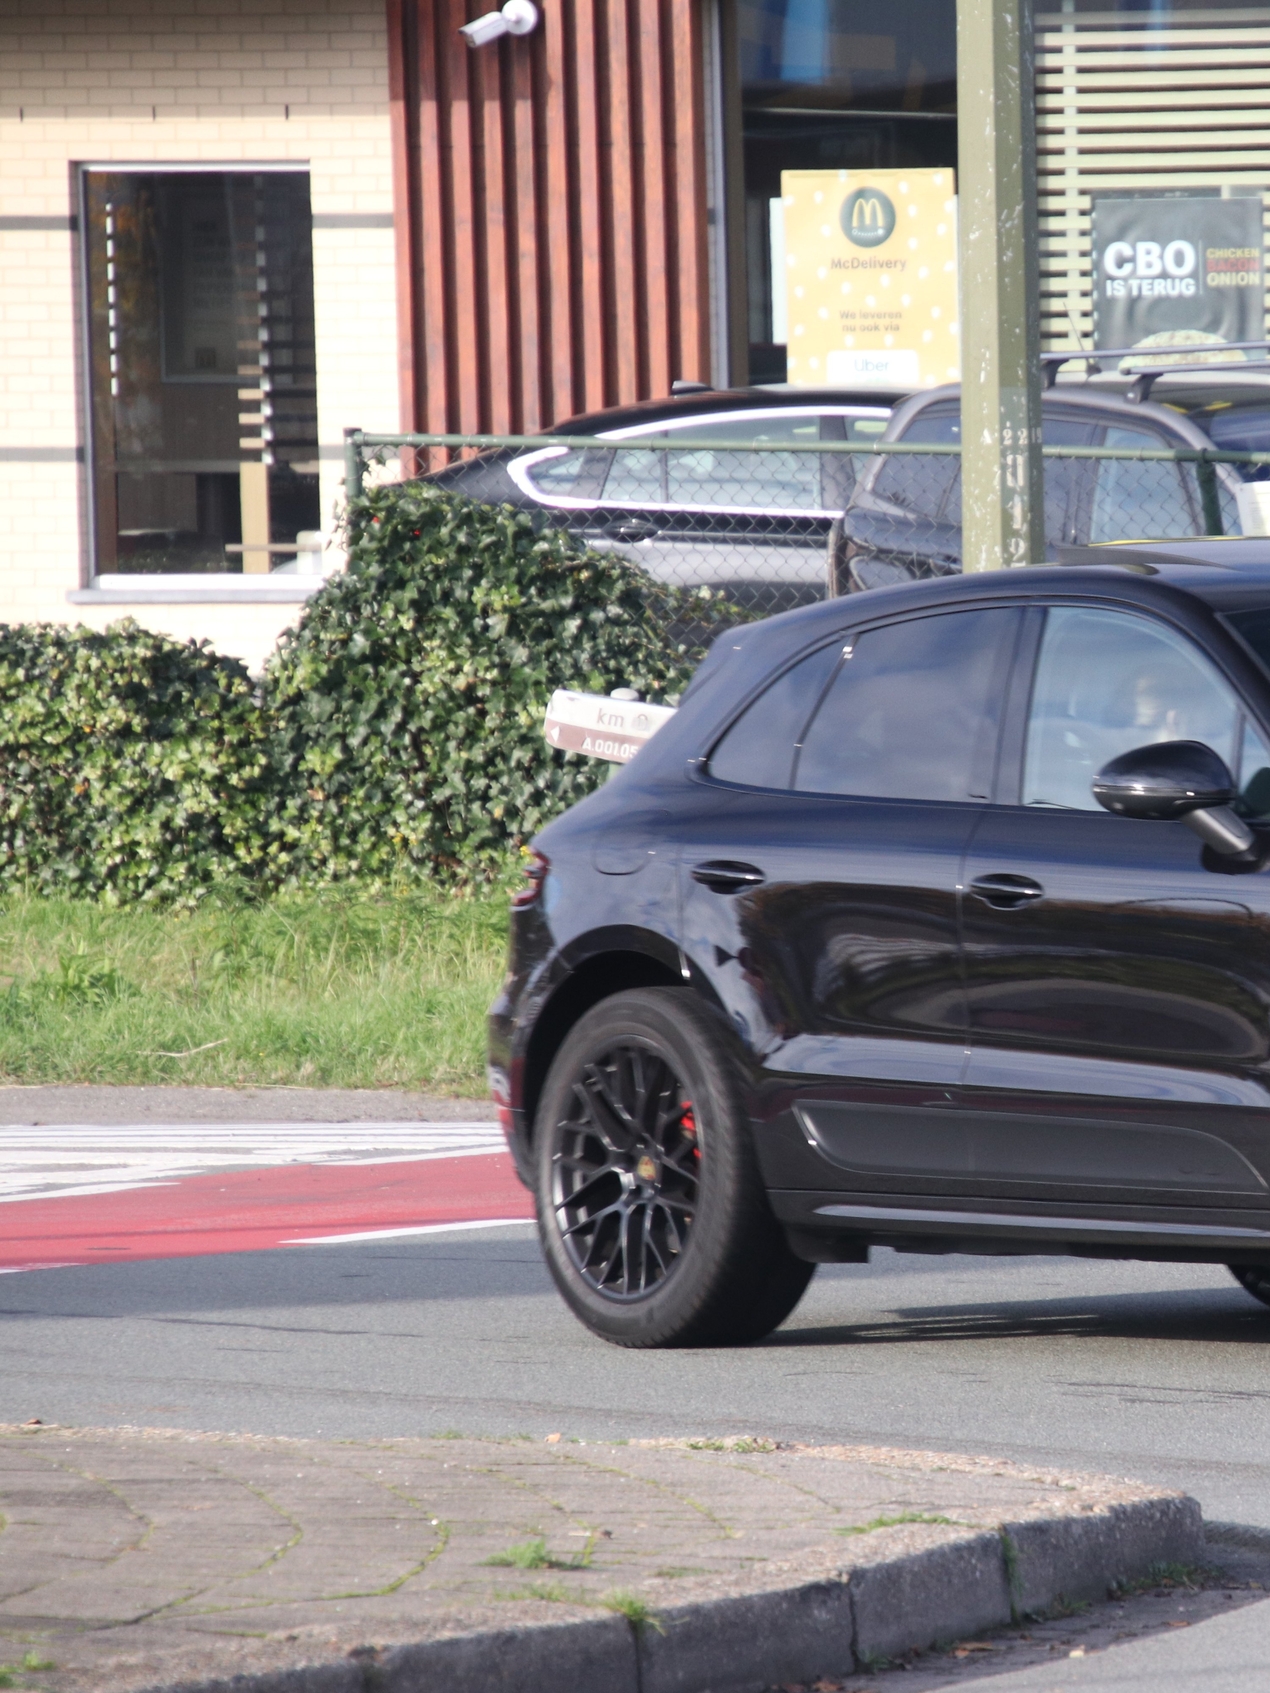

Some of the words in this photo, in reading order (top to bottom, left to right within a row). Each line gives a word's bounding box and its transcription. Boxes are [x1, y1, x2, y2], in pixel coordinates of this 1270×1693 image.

[1103, 240, 1196, 277] CBO
[1206, 248, 1260, 259] CHICKEN
[830, 257, 907, 272] McDelivery
[1206, 259, 1260, 272] BACON
[1206, 272, 1260, 287] ONION
[1106, 279, 1125, 297] IS
[1129, 278, 1196, 296] TERUG
[839, 310, 856, 320] We
[859, 309, 902, 320] leveren
[842, 323, 856, 333] nu
[859, 322, 881, 333] ook
[884, 321, 900, 332] via
[854, 358, 890, 372] Uber
[597, 707, 625, 728] km
